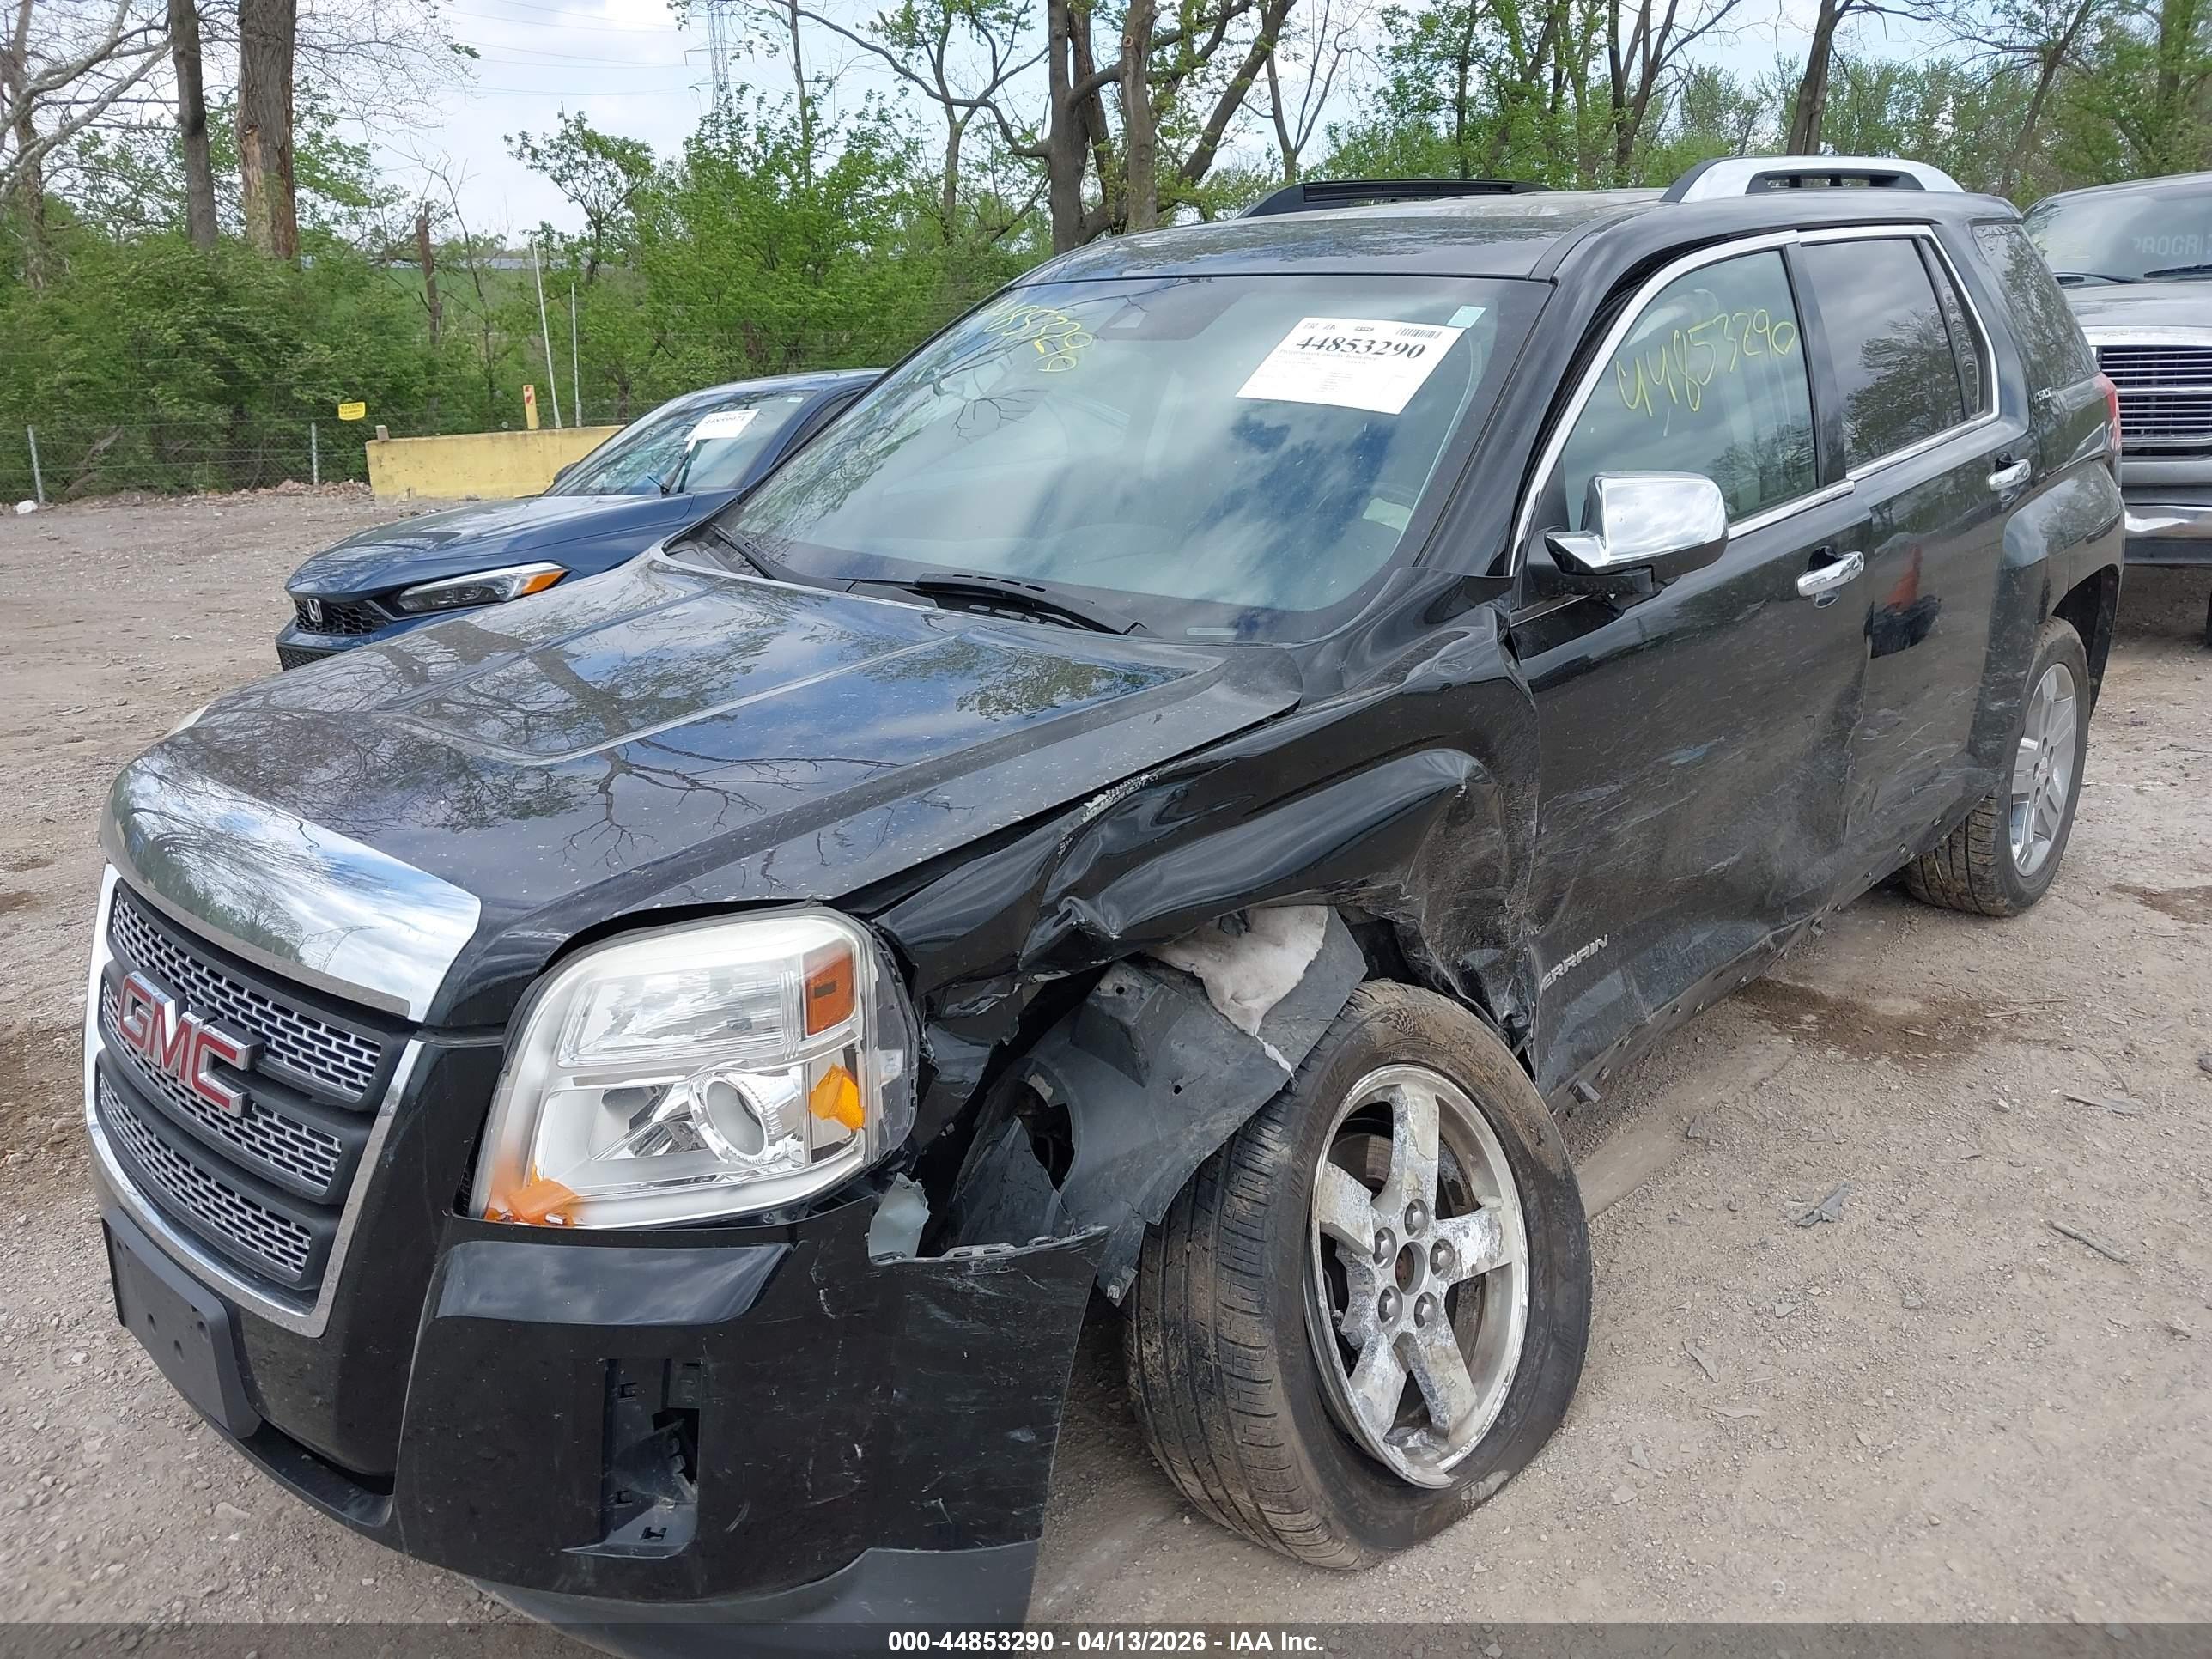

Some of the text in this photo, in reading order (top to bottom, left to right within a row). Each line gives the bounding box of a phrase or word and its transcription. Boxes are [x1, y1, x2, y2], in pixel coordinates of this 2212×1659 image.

[1296, 335, 1426, 359] 44853290
[1616, 308, 1796, 417] 44853290
[118, 969, 253, 1118] GMC
